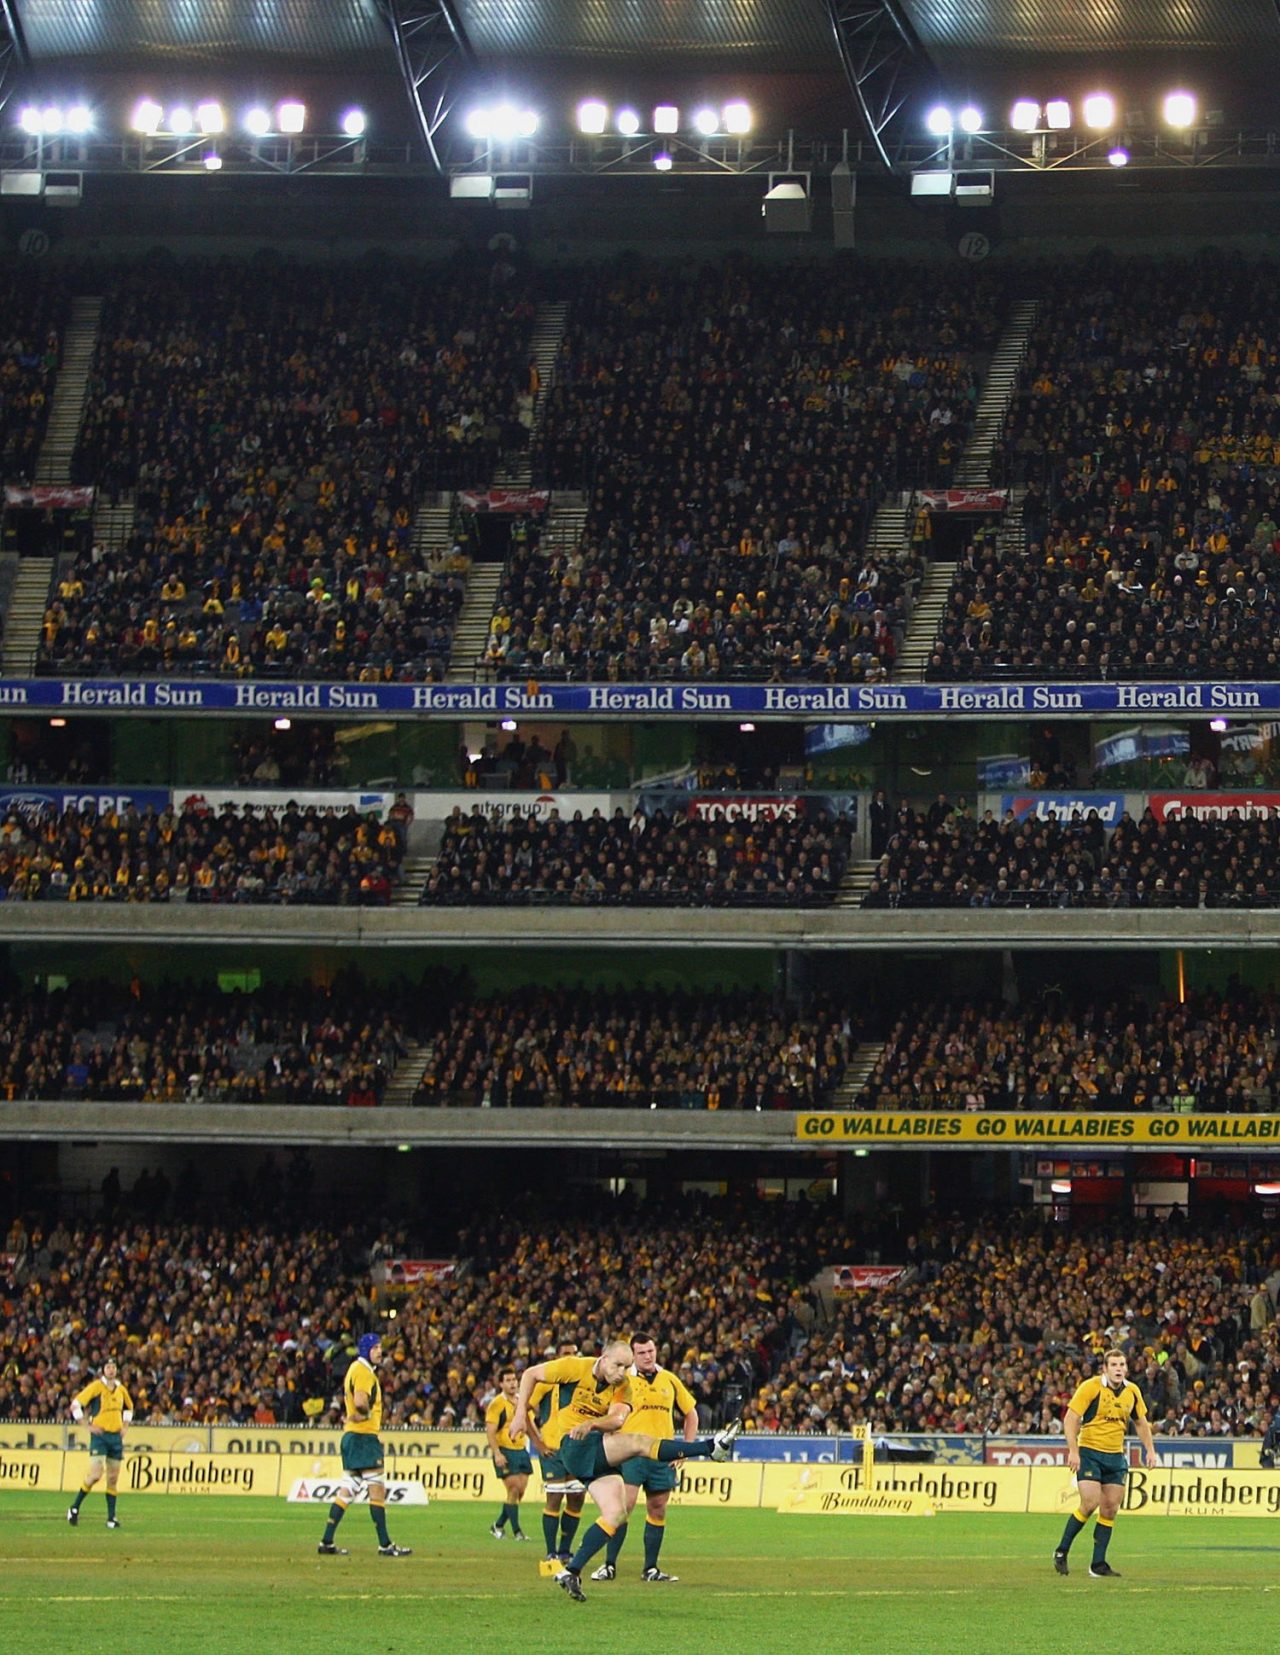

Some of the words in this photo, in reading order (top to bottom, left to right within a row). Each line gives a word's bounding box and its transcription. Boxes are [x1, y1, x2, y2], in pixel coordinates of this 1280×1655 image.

[62, 683, 146, 705] Herald
[154, 684, 202, 705] Sun
[235, 685, 320, 706] Herald
[329, 686, 377, 708] Sun
[412, 688, 497, 710] Herald
[505, 688, 554, 710] Sun
[588, 688, 673, 710] Herald
[682, 688, 731, 710] Sun
[764, 688, 849, 709] Herald
[858, 688, 907, 709] Sun
[939, 687, 1024, 708] Herald
[1033, 687, 1082, 708] Sun
[1116, 686, 1202, 708] Herald
[1210, 685, 1260, 707] Sun
[805, 1118, 834, 1135] GO
[843, 1118, 961, 1135] WALLABIES
[976, 1119, 1006, 1135] GO
[1015, 1120, 1134, 1136] WALLABIES
[1149, 1120, 1179, 1136] GO
[856, 1427, 865, 1438] 22
[127, 1453, 254, 1491] Bundaberg
[821, 1492, 913, 1512] Bundaberg
[1184, 1507, 1225, 1516] RUM
